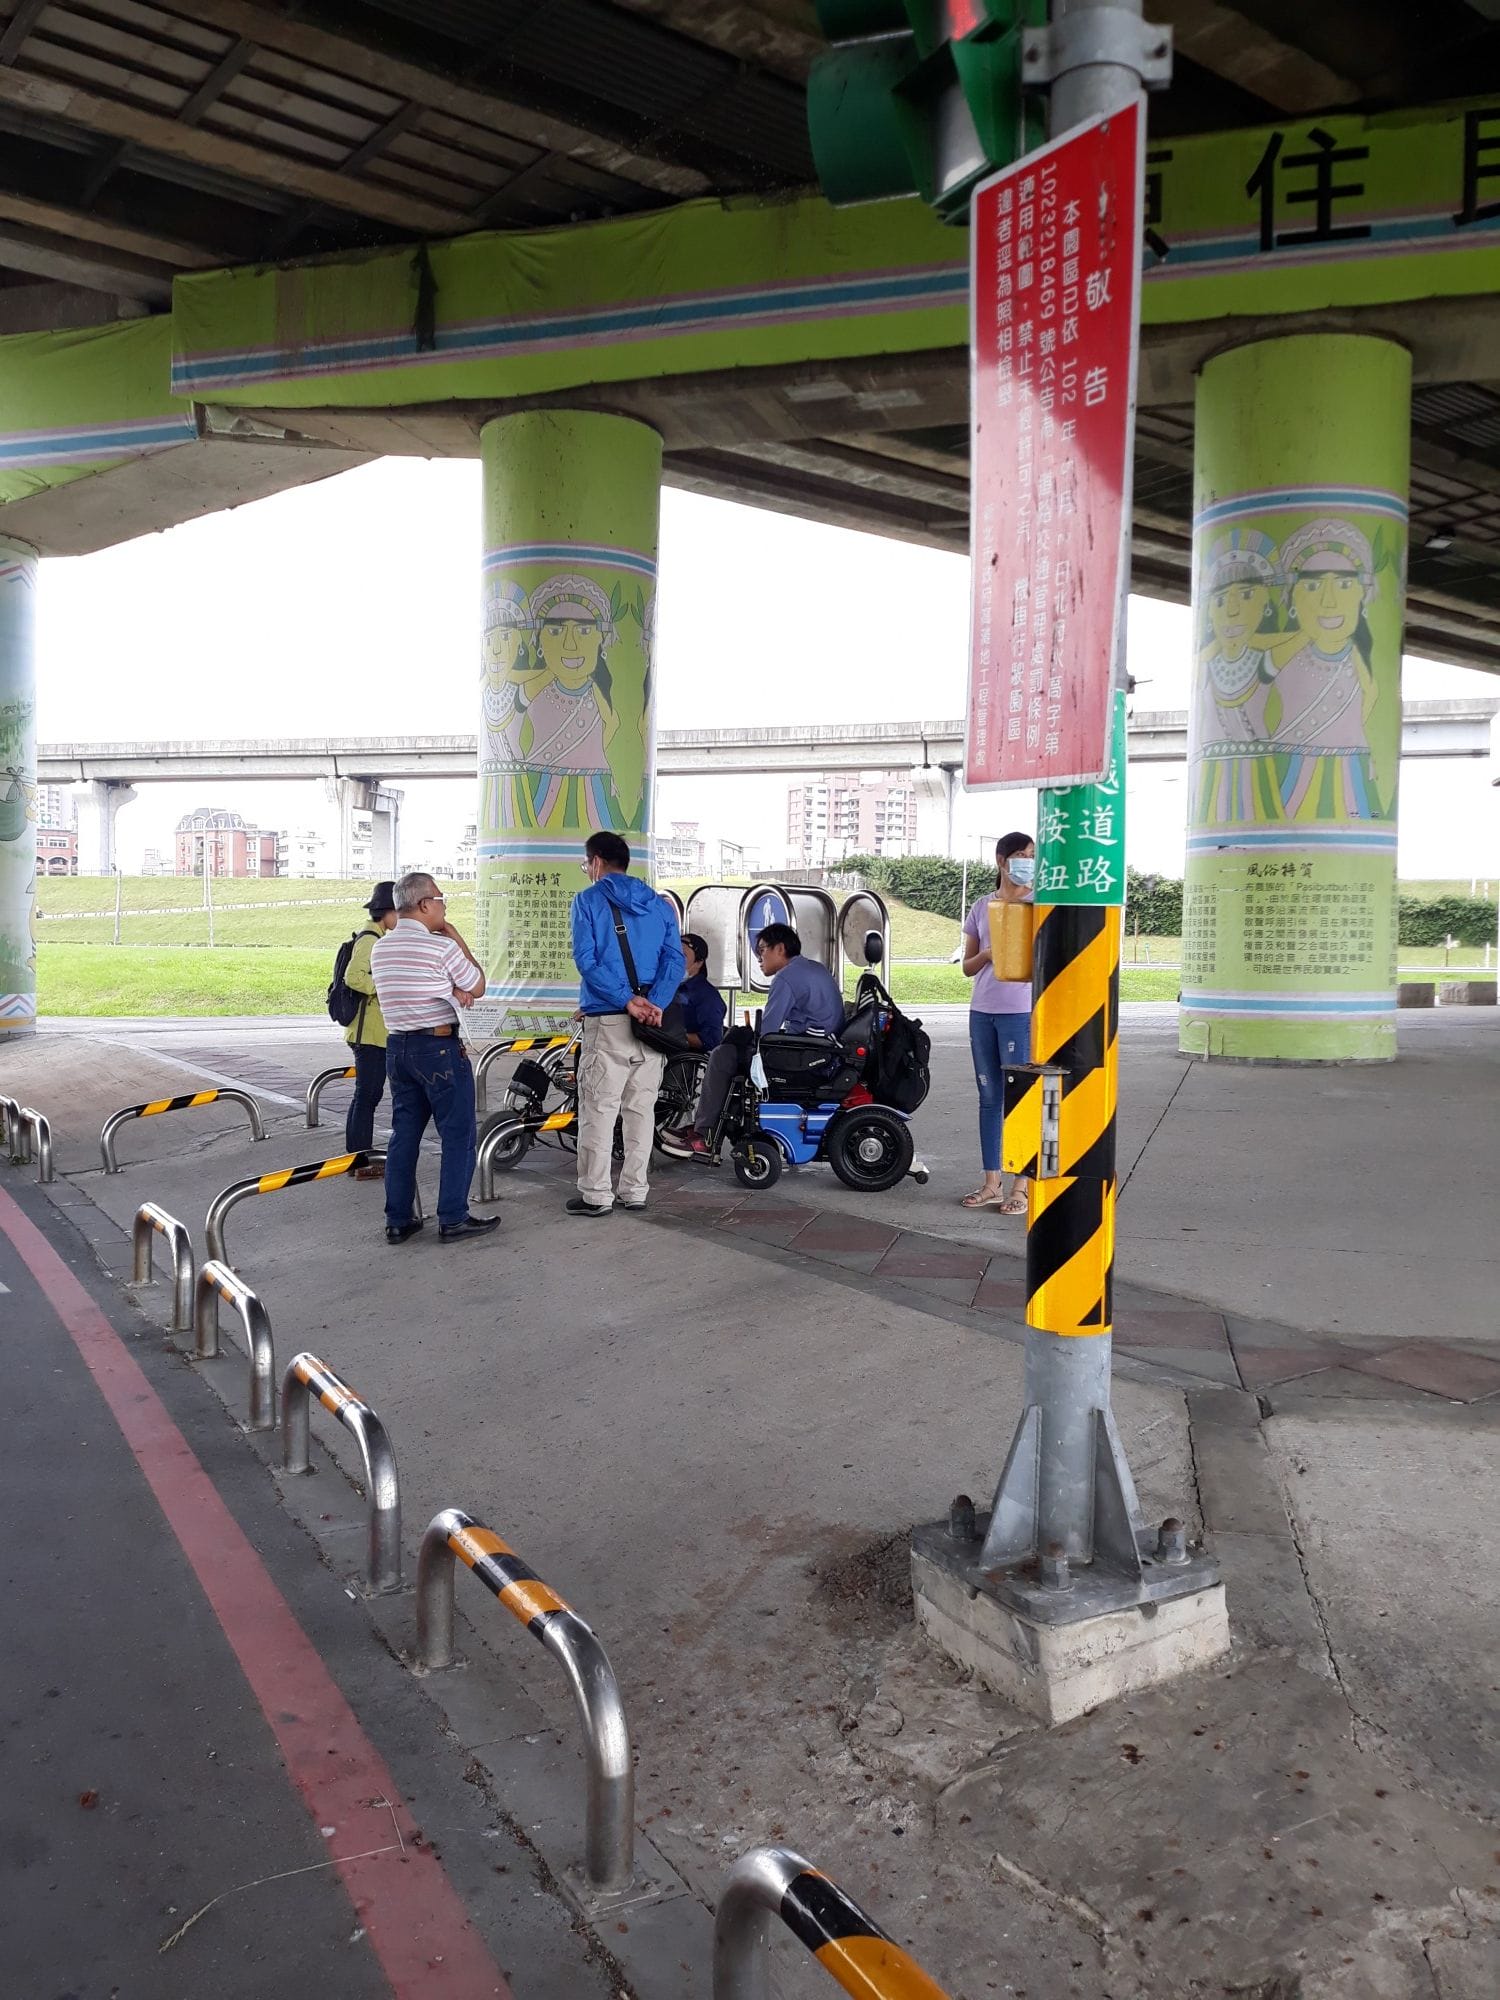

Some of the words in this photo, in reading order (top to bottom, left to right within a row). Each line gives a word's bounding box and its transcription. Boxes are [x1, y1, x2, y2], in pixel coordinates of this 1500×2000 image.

[1036, 787, 1071, 891] 按鈕
[1246, 862, 1314, 878] 風俗特質
[509, 872, 562, 887] 風俗特質
